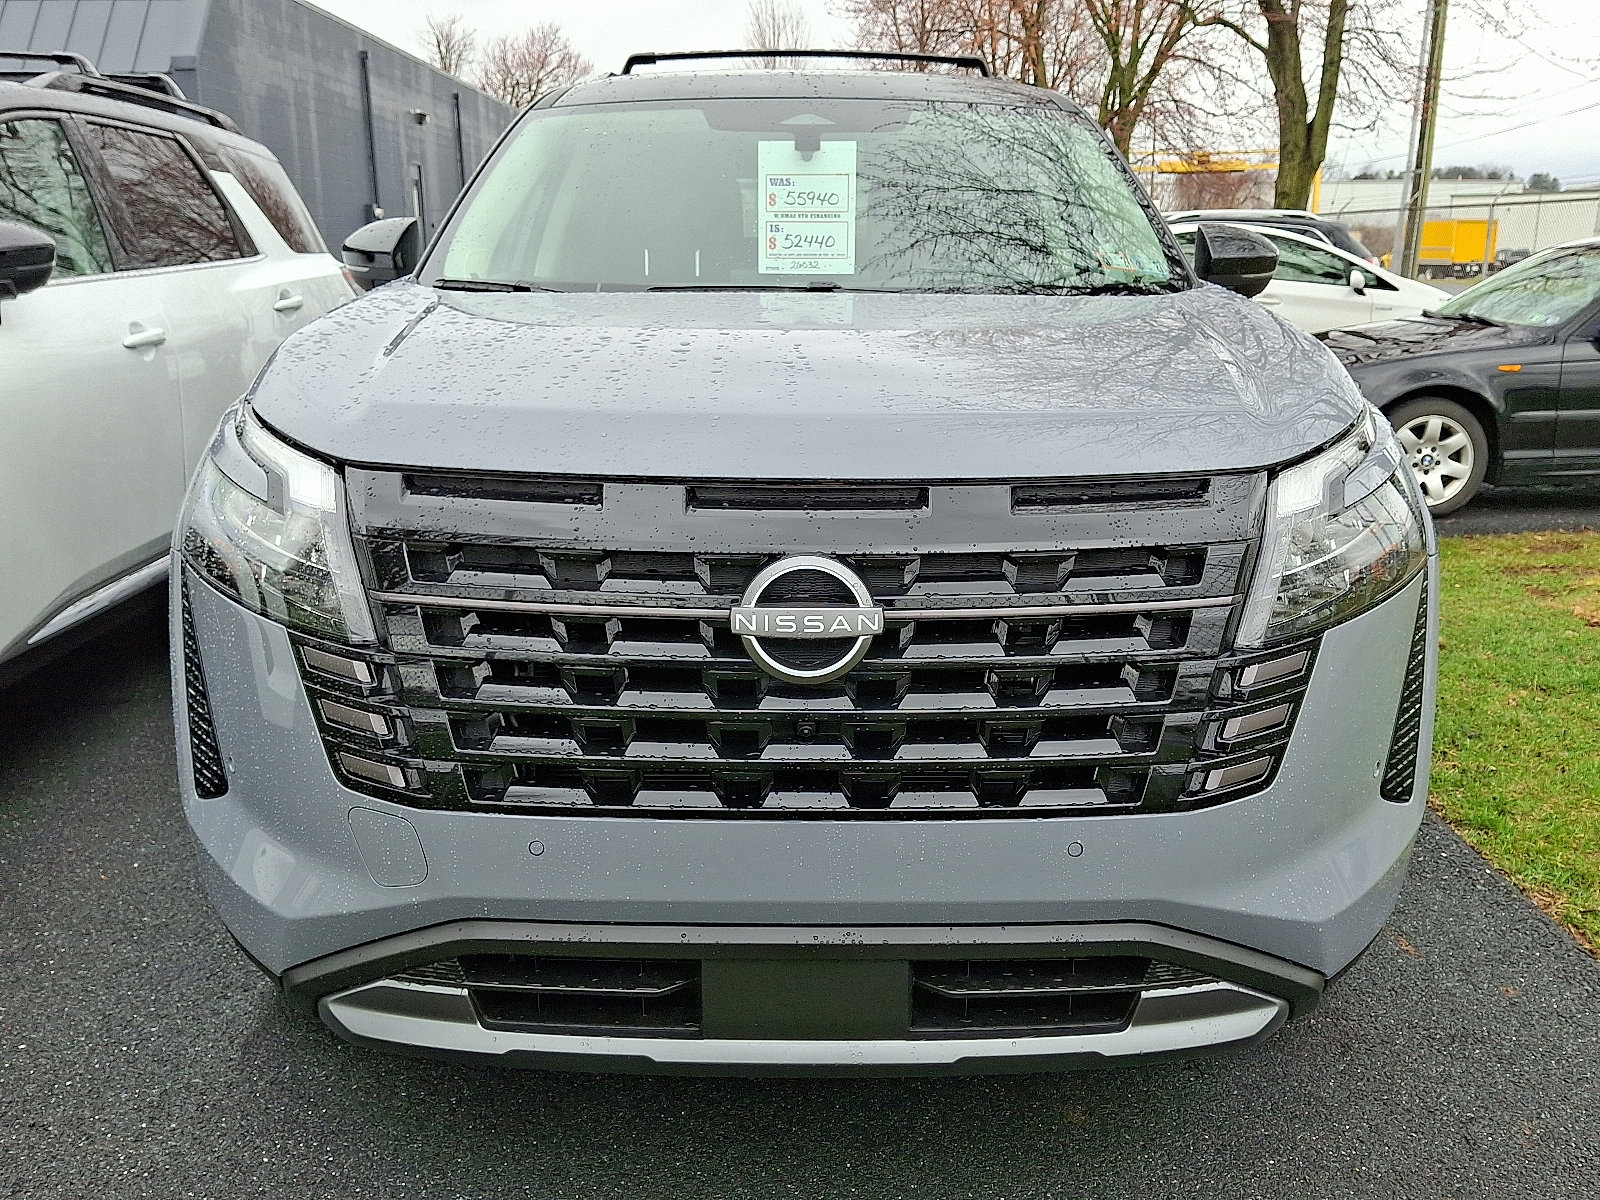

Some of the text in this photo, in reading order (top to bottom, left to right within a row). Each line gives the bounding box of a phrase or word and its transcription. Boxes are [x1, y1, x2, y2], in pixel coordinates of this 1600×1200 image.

[769, 177, 796, 187] WAS:
[768, 191, 840, 207] $ 55940
[769, 224, 784, 233] IS:
[768, 233, 836, 250] $ 52440
[735, 613, 880, 633] NISSAN
